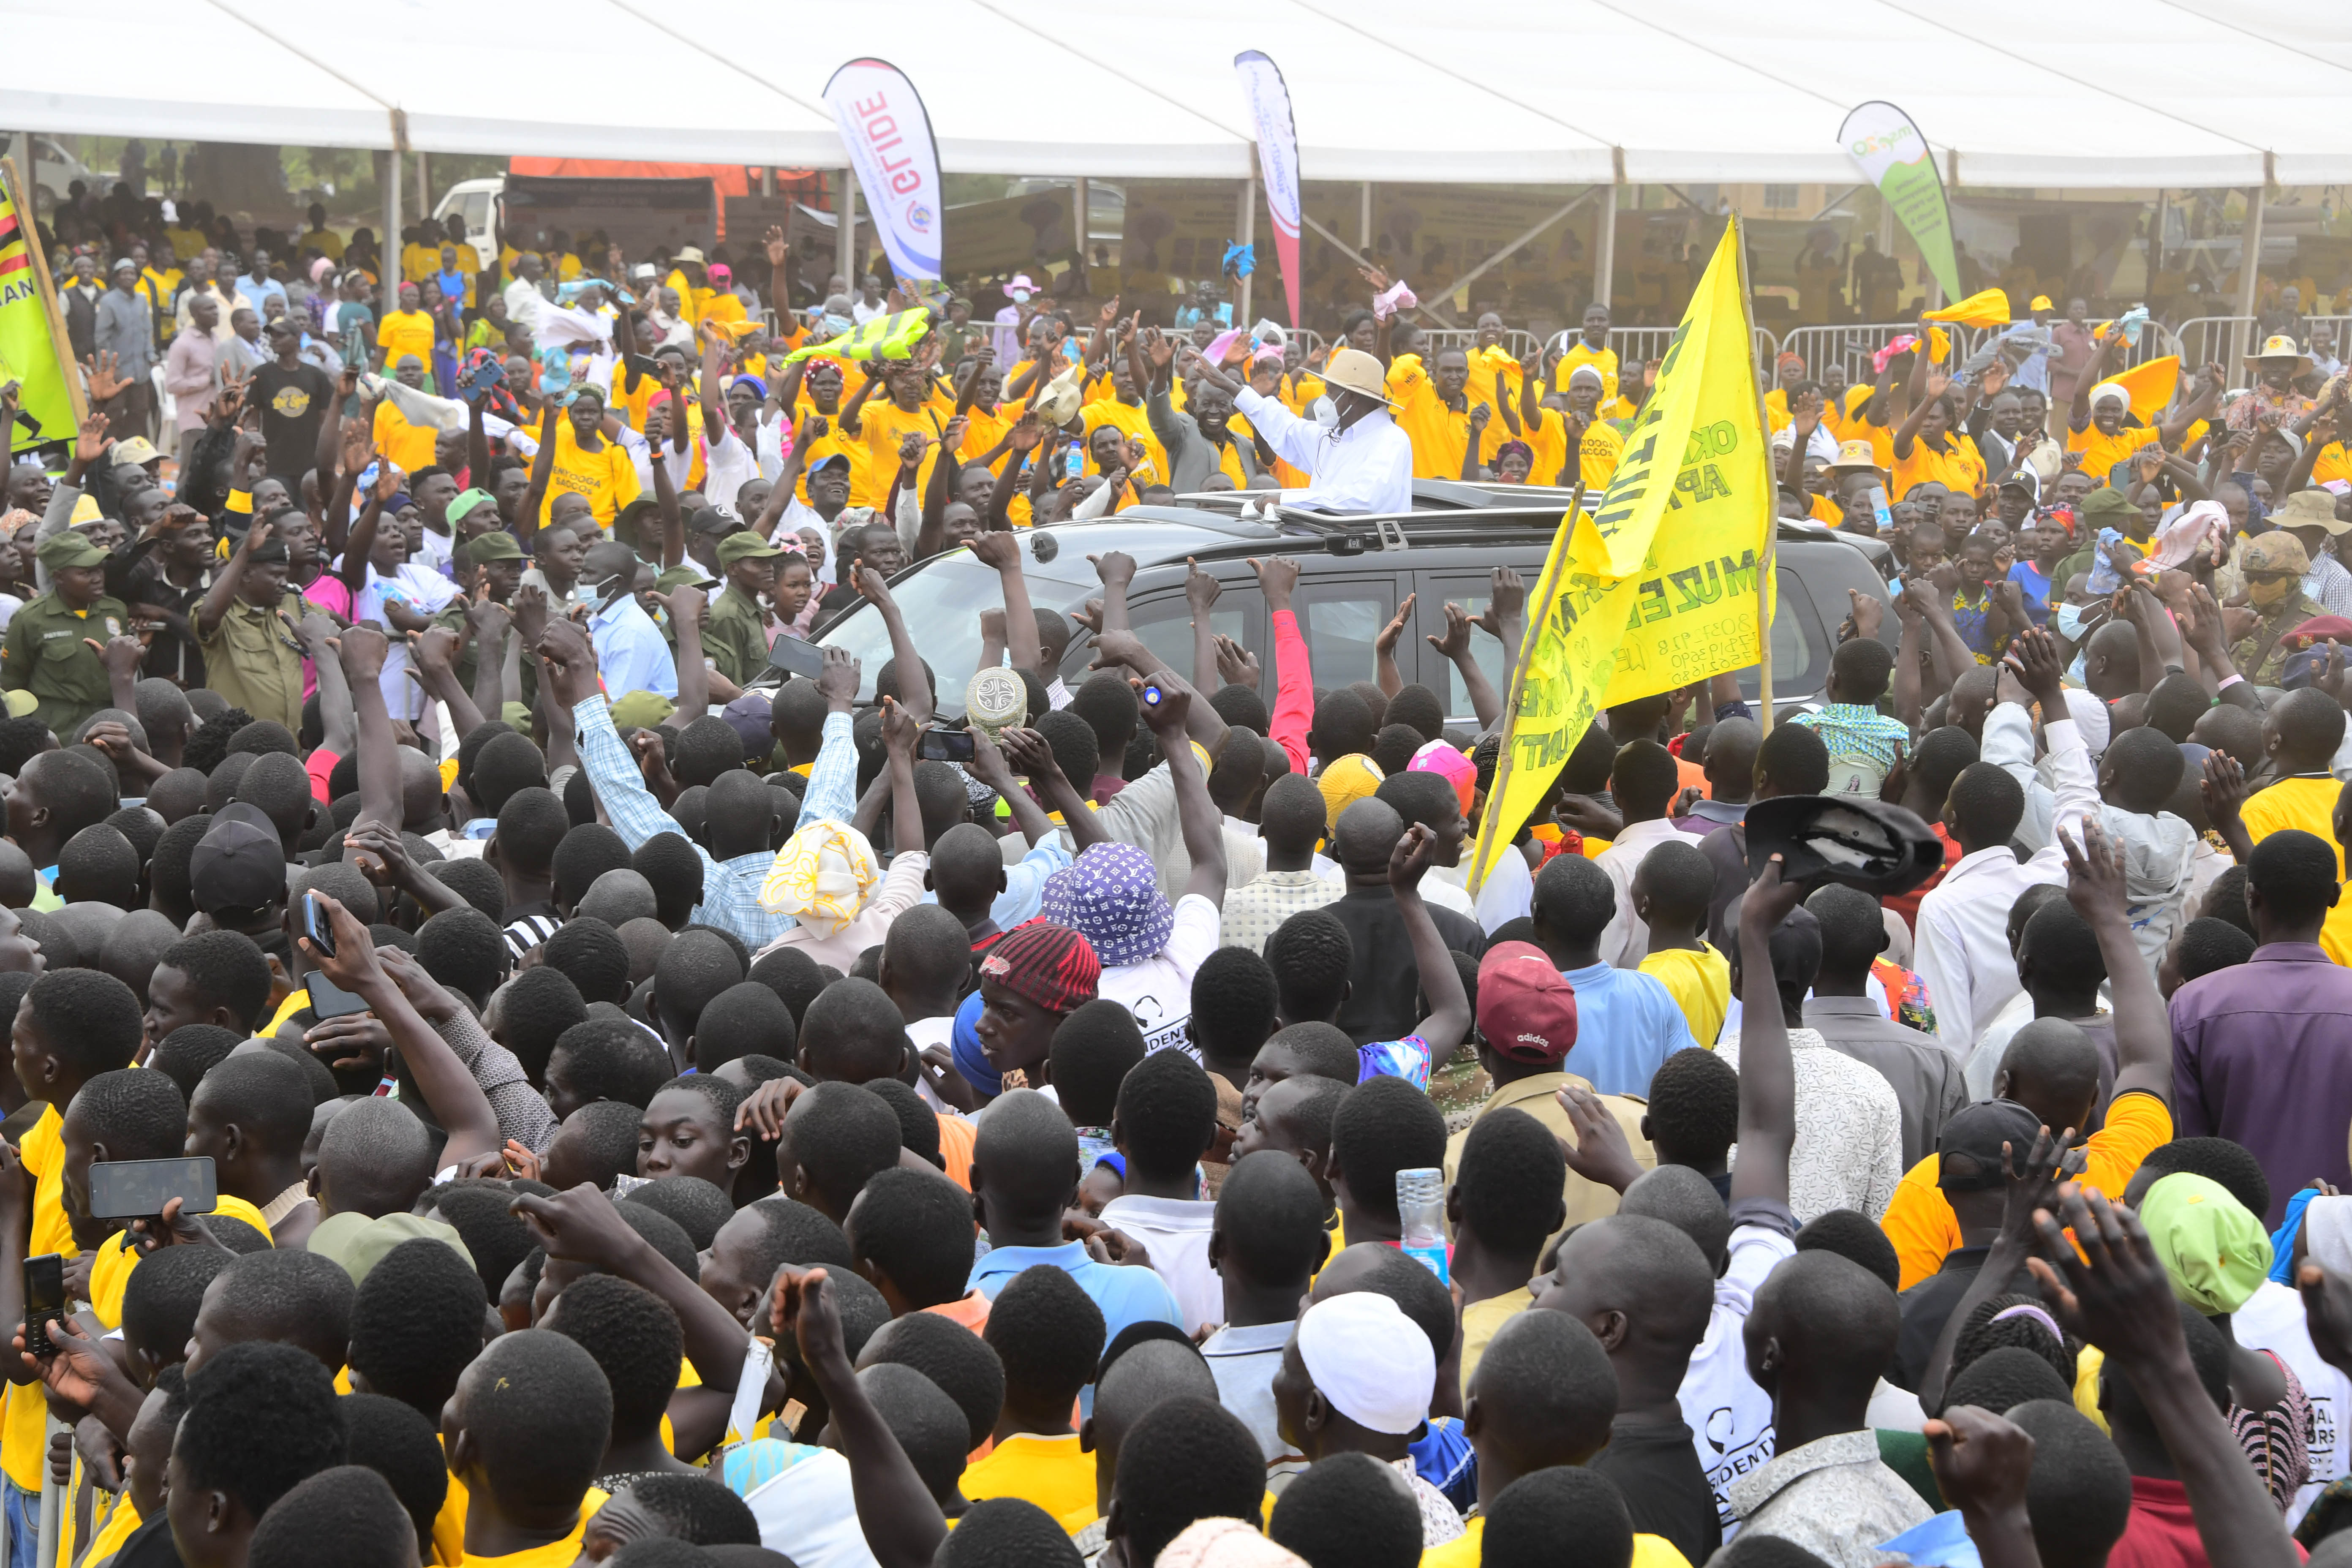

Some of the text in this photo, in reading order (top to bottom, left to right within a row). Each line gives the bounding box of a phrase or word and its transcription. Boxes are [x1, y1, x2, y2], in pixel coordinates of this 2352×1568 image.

[0, 278, 34, 306] AN
[1580, 438, 1614, 449] YOOGA
[1580, 448, 1612, 457] ACCOs
[556, 477, 592, 495] SACCOs
[1517, 1033, 1549, 1047] adidas
